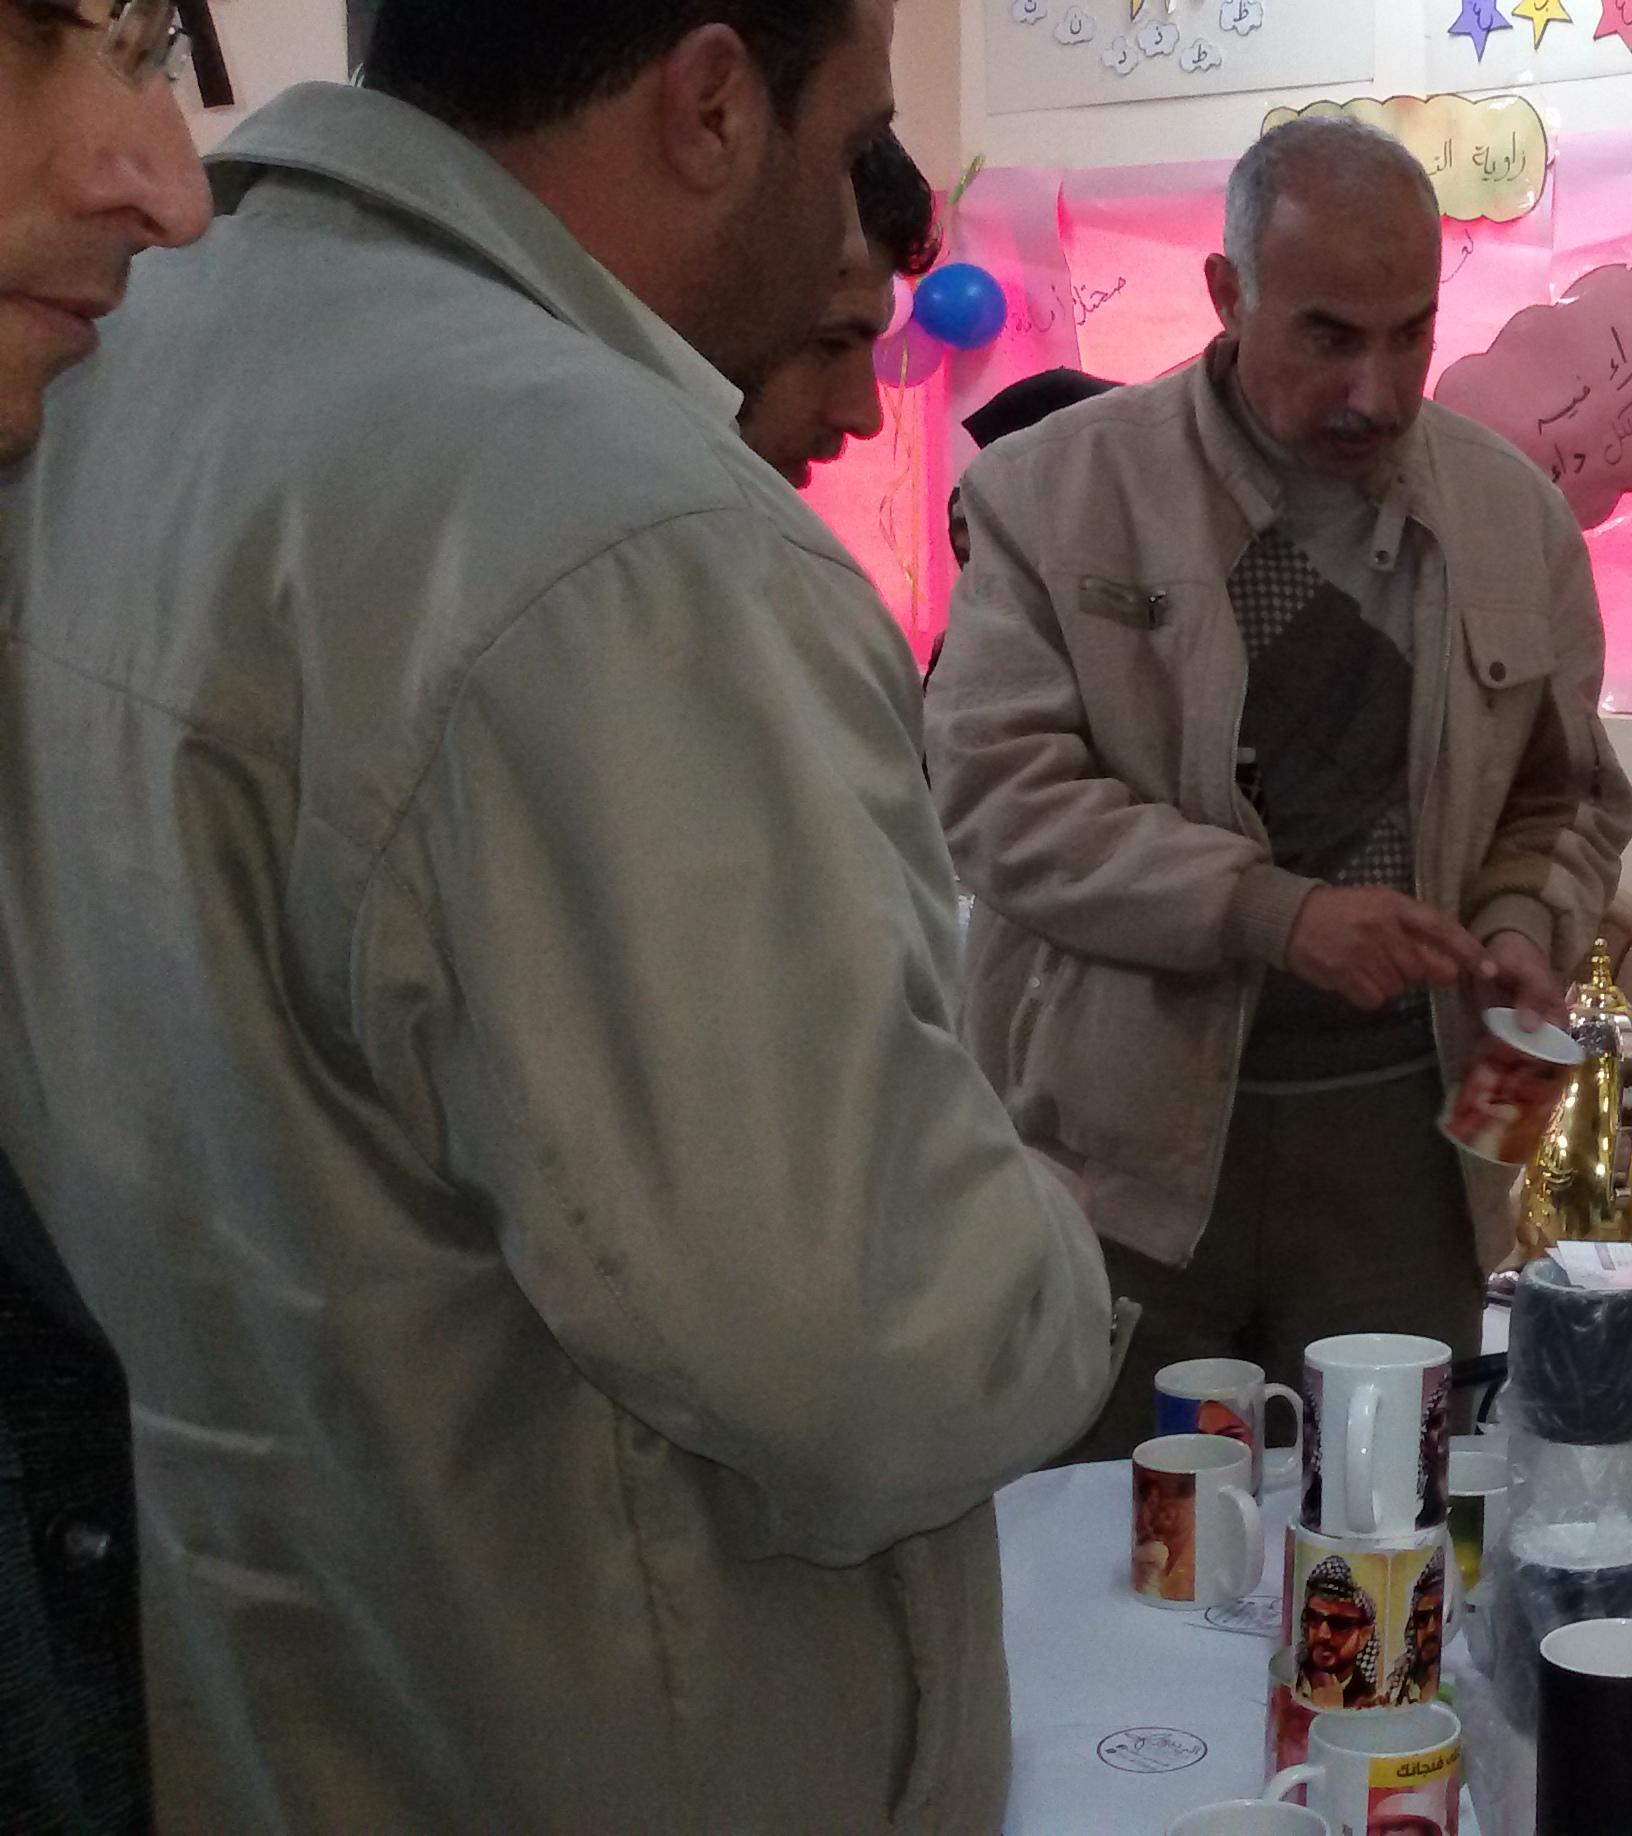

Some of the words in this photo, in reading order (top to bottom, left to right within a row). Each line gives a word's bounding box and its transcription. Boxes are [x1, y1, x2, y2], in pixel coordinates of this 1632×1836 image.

[1471, 131, 1527, 182] زاوية
[1551, 442, 1587, 484] داء
[1396, 1755, 1445, 1778] فنجانك
